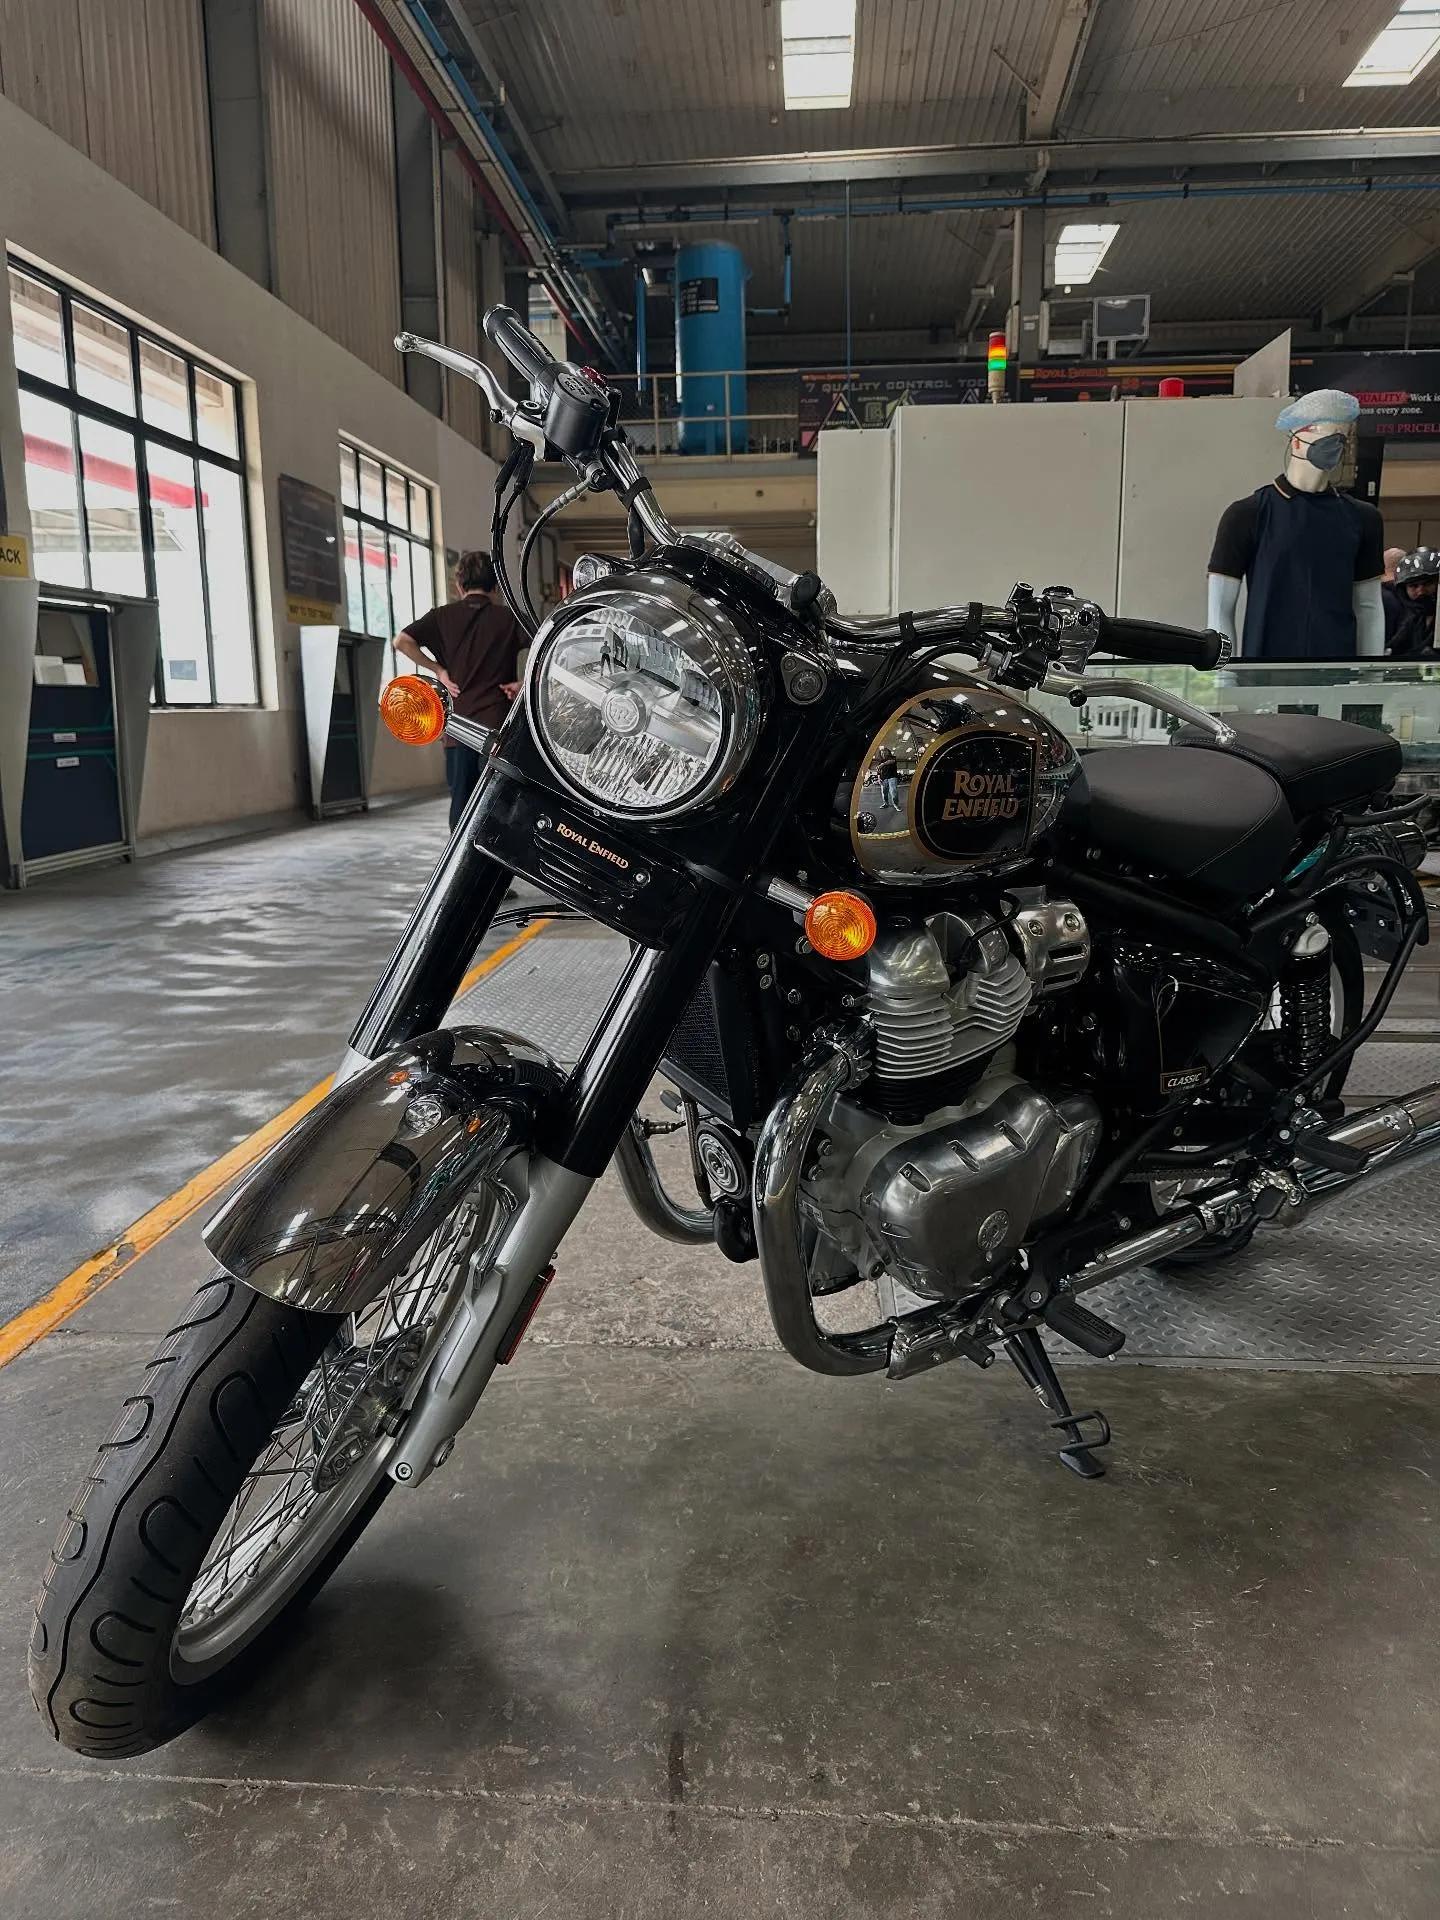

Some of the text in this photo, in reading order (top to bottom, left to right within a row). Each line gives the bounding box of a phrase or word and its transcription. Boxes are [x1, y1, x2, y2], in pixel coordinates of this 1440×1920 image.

[805, 382, 815, 393] 7
[821, 381, 881, 393] QUALITY
[886, 379, 952, 391] CONTROL
[1410, 393, 1432, 402] Work
[1376, 407, 1399, 417] every
[1400, 407, 1423, 415] zone.
[1397, 423, 1440, 433] PRICEL
[0, 547, 22, 565] ACK
[953, 770, 1015, 797] ROYAL
[941, 798, 1019, 821] ENFIELD
[556, 822, 629, 869] ROYAL ENFIELD
[1167, 1073, 1202, 1088] CLASSIC
